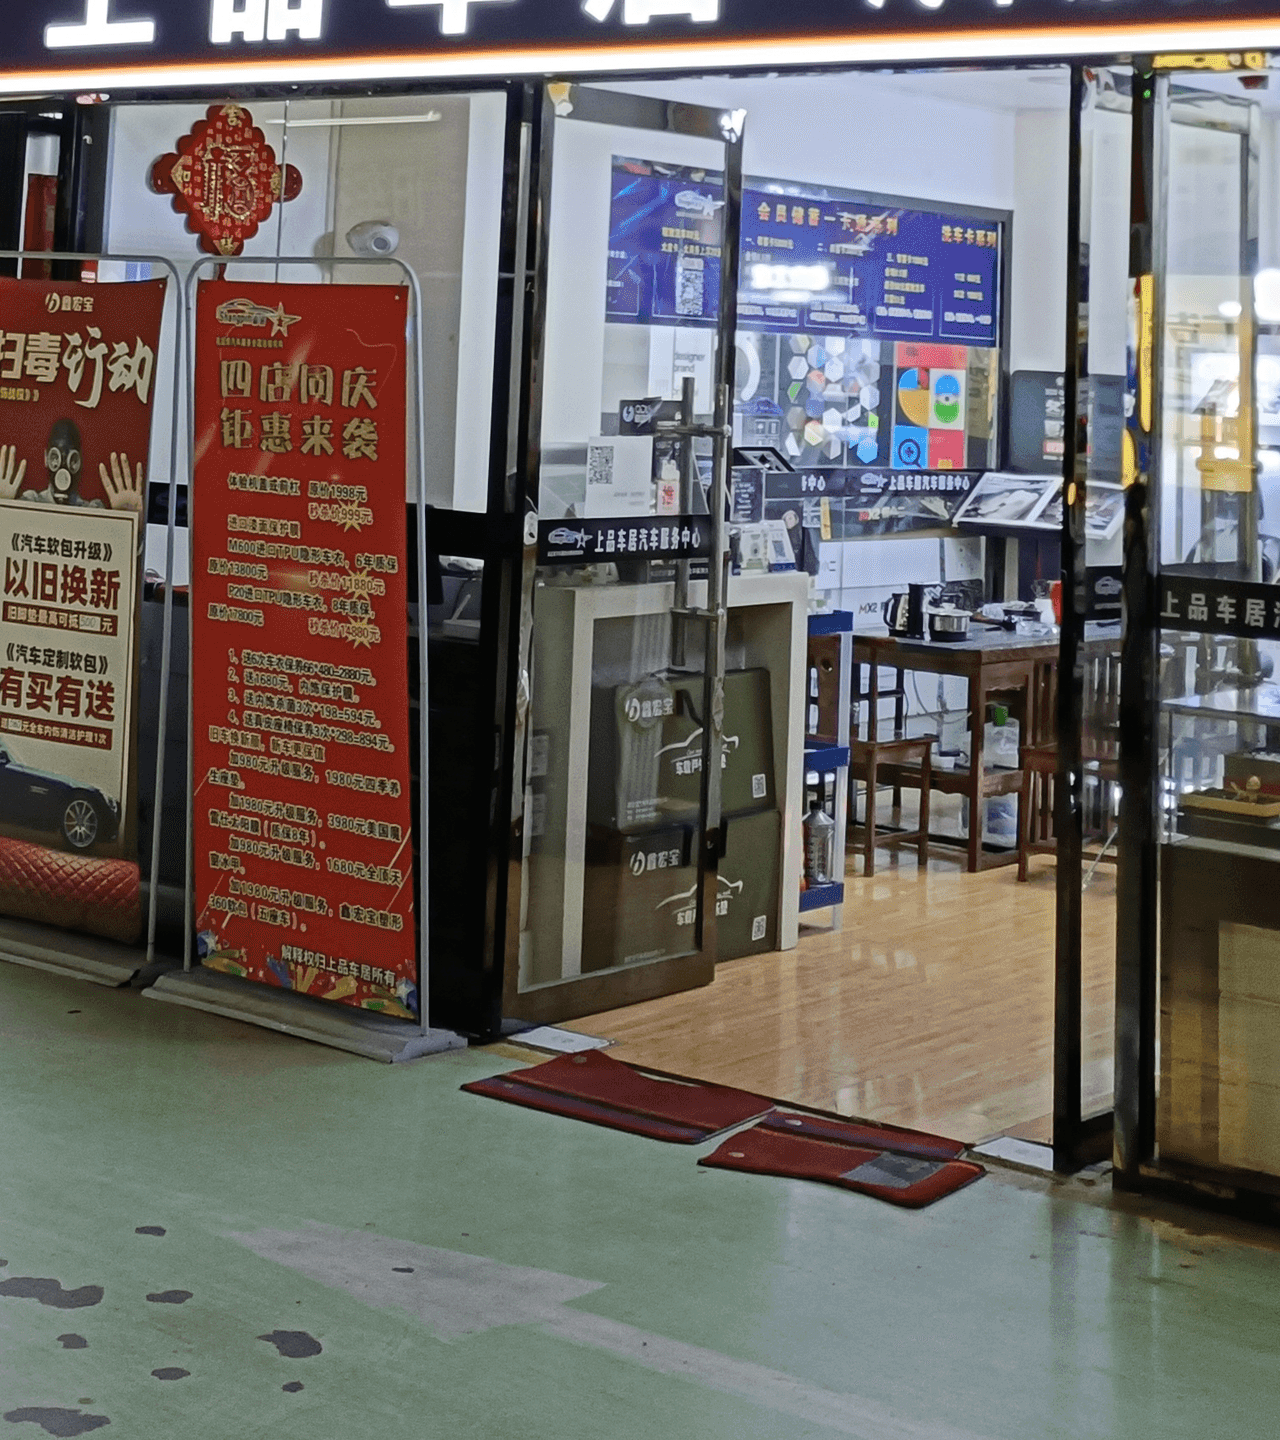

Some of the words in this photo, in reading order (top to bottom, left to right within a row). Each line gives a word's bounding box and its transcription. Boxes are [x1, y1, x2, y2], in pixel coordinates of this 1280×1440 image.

[220, 360, 378, 409] 四店同庆
[220, 407, 379, 462] 钜惠来袭
[308, 480, 368, 503] 原价1998元
[308, 502, 374, 526] 秒杀价999元
[11, 532, 113, 563] 《汽车软包升级》
[594, 526, 701, 553] 上品车居汽车服务中心
[3, 557, 121, 611] 以旧换新
[208, 557, 269, 581] 原价13800元
[208, 602, 265, 627] 原价17800元
[308, 617, 382, 644] 秒杀价14880元
[5, 642, 109, 675] 《汽车定制软包》
[281, 944, 396, 987] 解释权归上品车居所有
